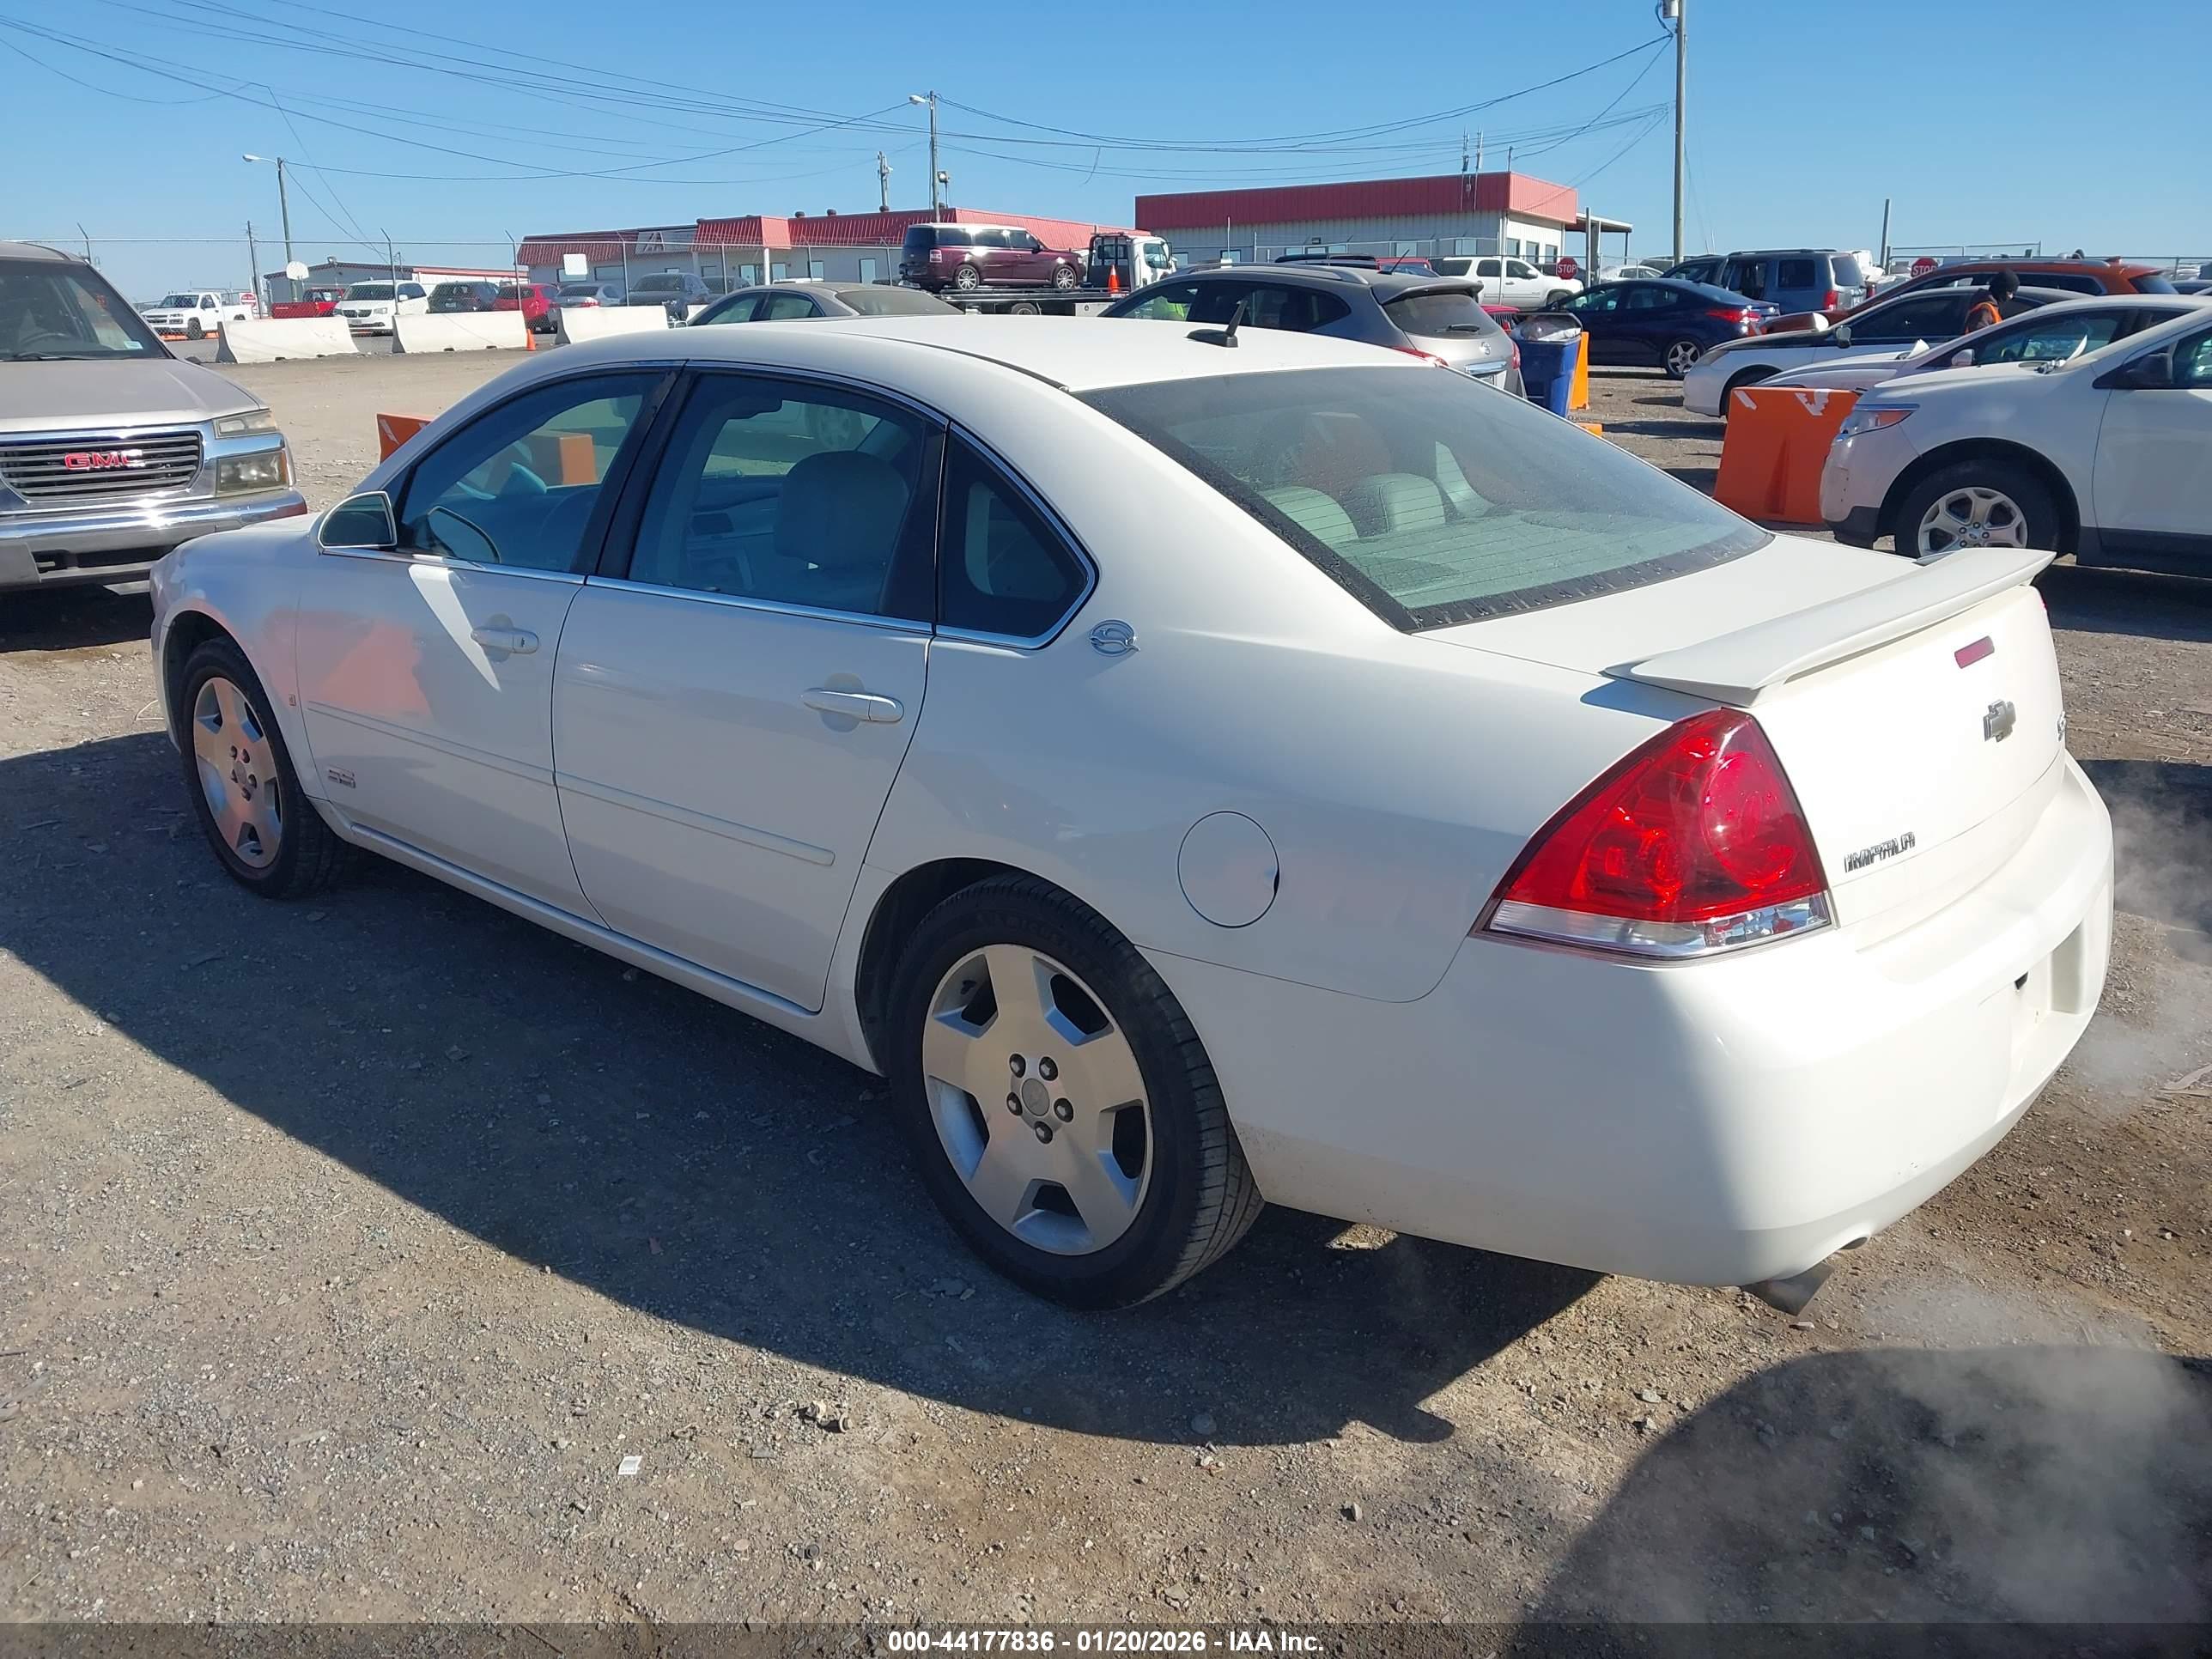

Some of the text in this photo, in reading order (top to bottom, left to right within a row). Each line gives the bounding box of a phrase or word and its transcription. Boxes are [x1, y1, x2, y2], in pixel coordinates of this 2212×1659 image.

[1558, 264, 1577, 274] STOP
[64, 449, 145, 471] GMC
[1844, 830, 1916, 873] IMPALA
